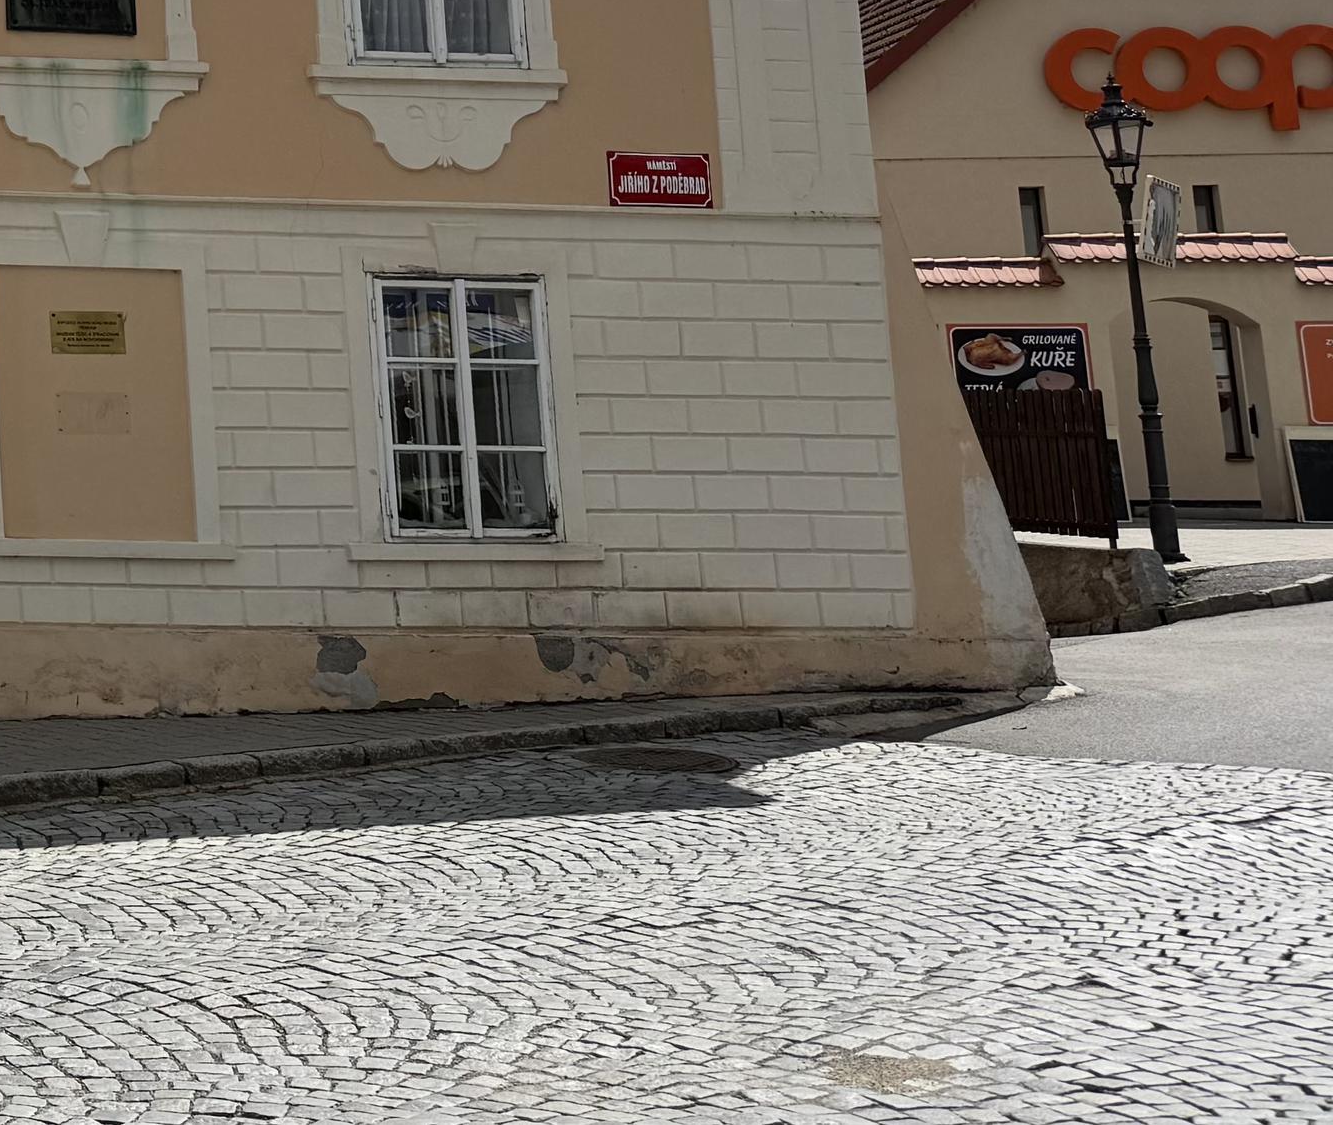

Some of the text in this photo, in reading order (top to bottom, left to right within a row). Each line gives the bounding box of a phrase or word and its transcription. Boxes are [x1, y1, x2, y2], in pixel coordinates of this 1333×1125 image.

[1044, 24, 1333, 131] coop
[646, 160, 676, 170] NÁMĚSTÍ
[618, 171, 707, 195] JIŘÍHO Z PODĚBRAD
[1022, 332, 1077, 345] GRILOVANÉ
[1030, 347, 1076, 368] KUŘE
